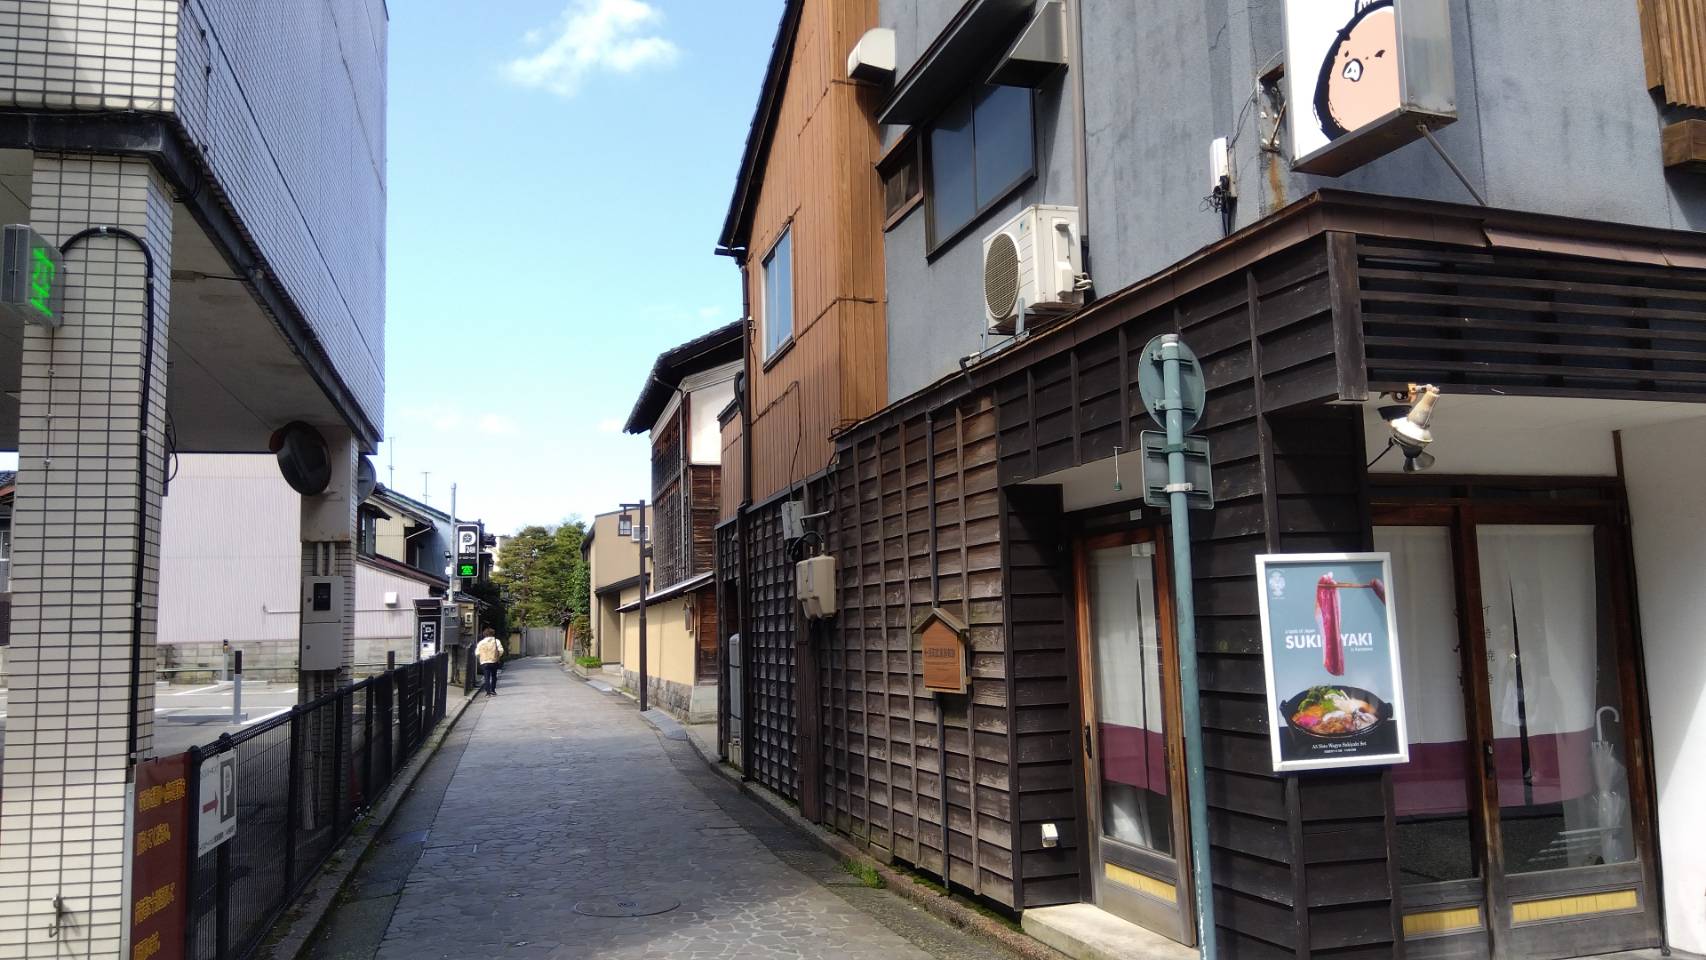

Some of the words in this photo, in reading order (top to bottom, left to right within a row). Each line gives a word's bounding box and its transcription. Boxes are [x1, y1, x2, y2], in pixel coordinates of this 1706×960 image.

[459, 531, 476, 553] P
[1285, 634, 1322, 649] SUKI
[1340, 632, 1373, 647] YAKI
[223, 764, 233, 815] P
